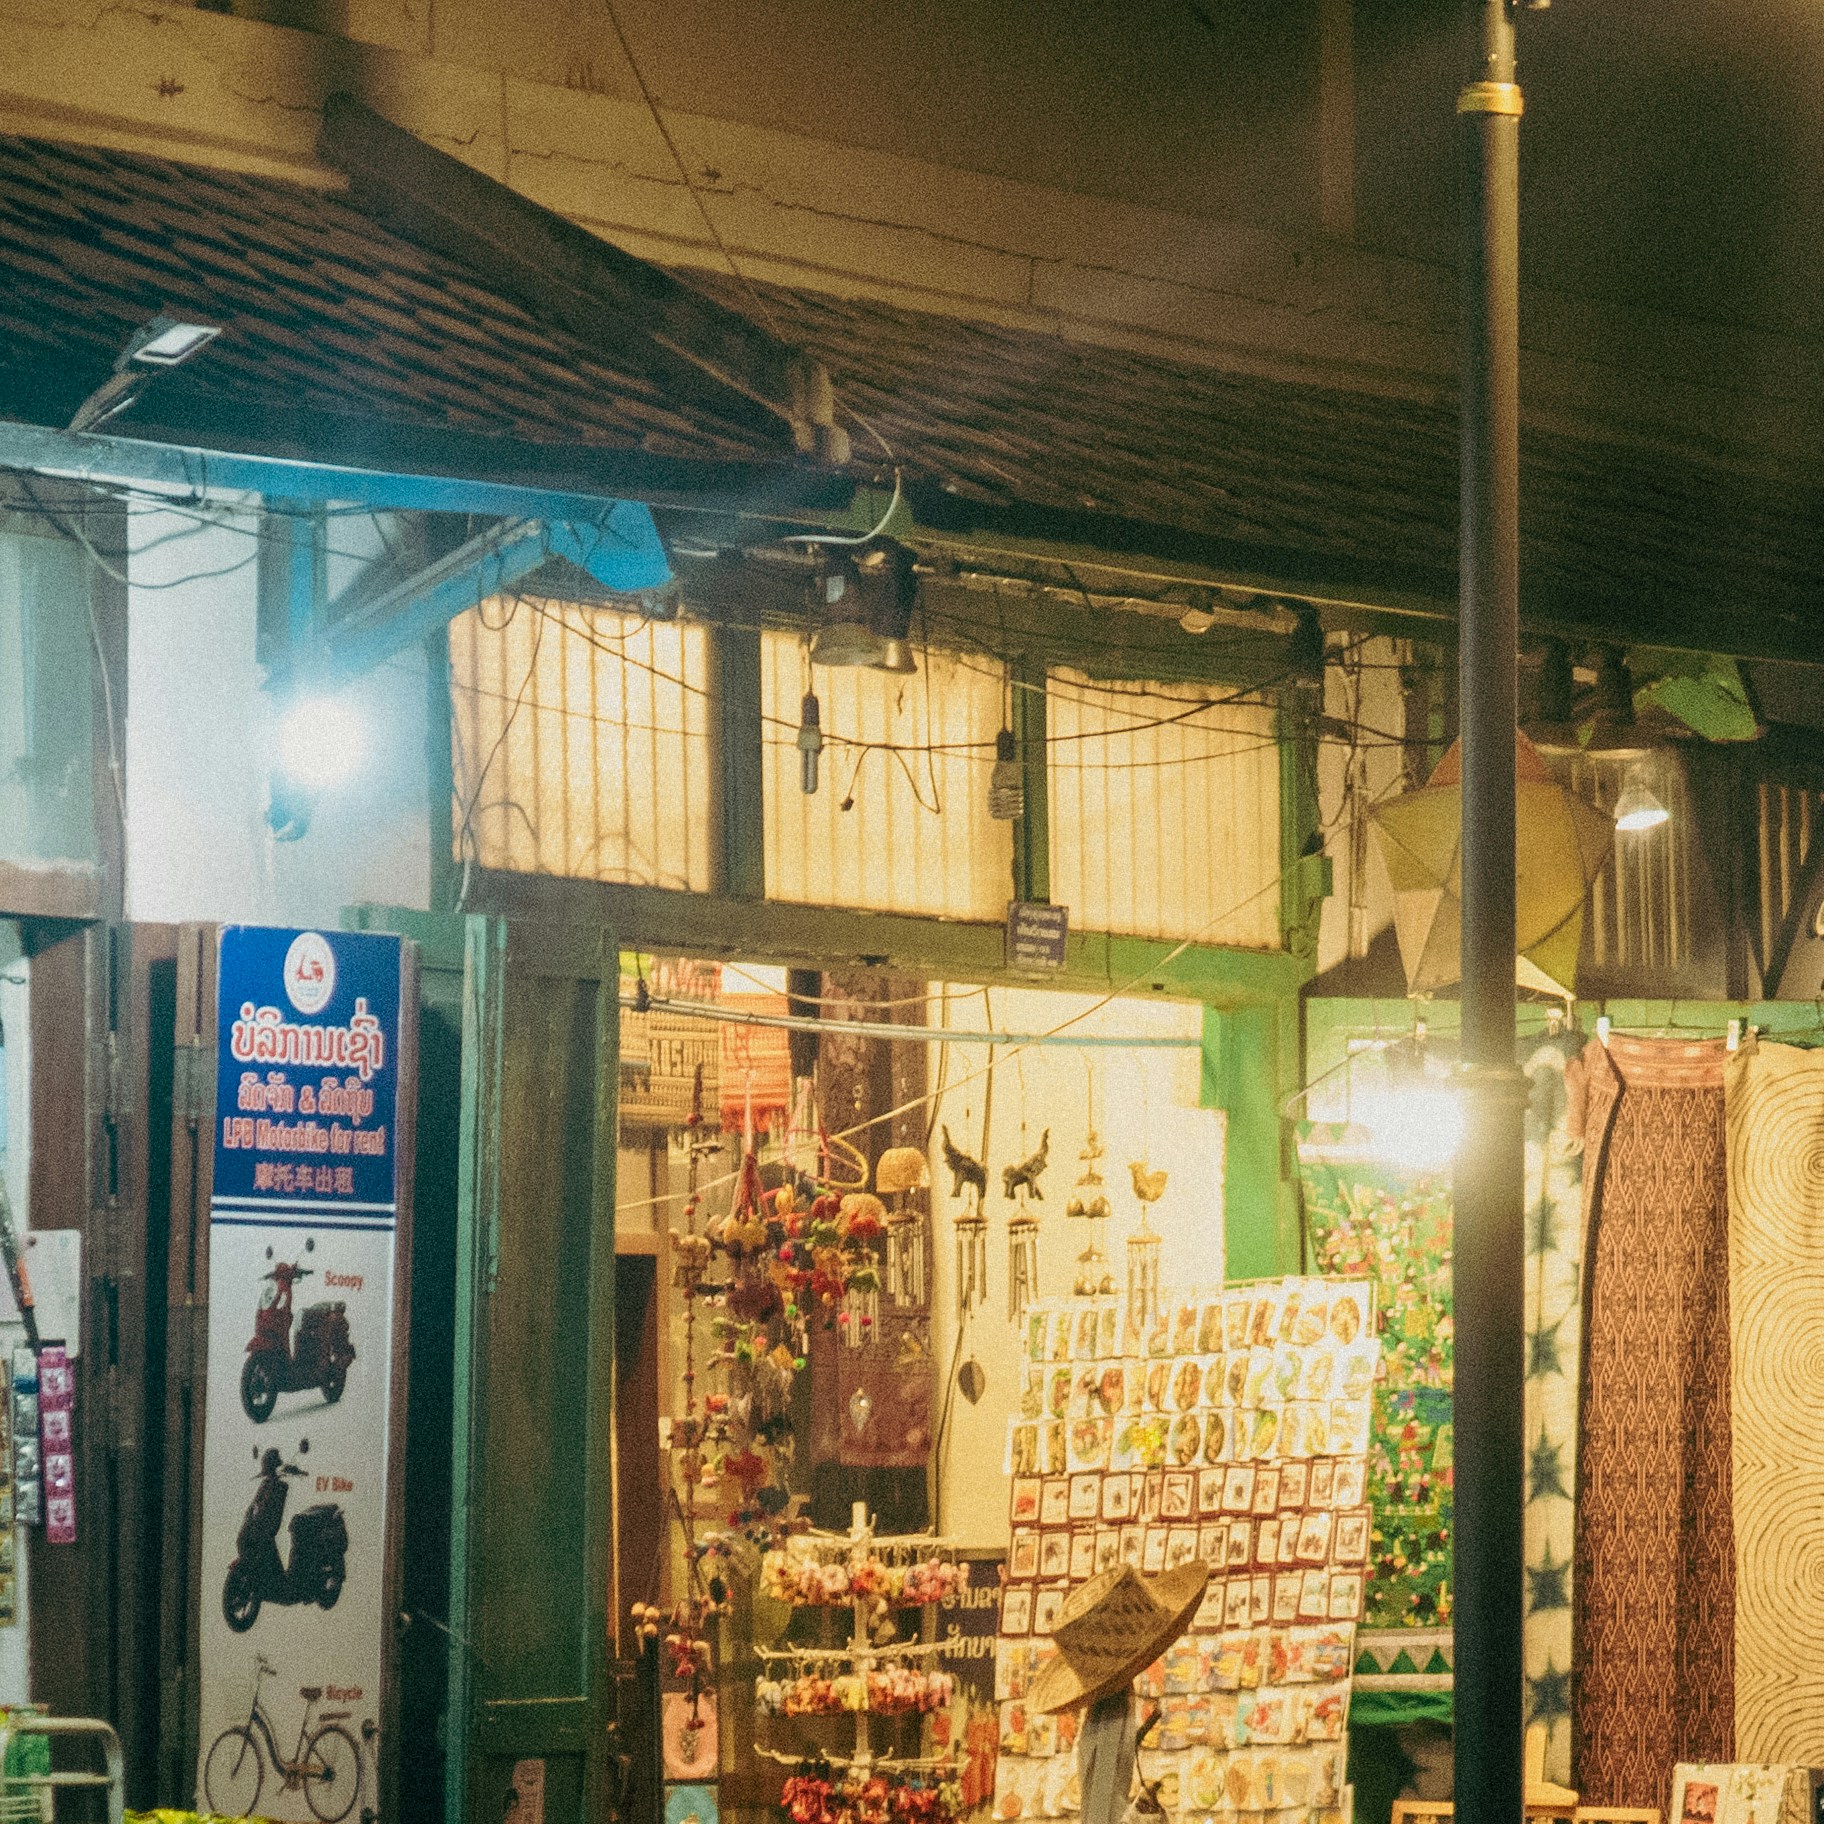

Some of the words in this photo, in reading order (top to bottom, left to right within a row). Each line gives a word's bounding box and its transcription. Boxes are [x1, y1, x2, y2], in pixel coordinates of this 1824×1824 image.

[299, 1085, 316, 1114] &
[223, 1116, 254, 1149] LPB
[256, 1119, 328, 1153] Motorbike
[330, 1122, 352, 1154] for
[353, 1125, 385, 1156] rent
[324, 1269, 364, 1292] Scoopy
[316, 1476, 330, 1492] EV
[332, 1476, 354, 1492] Bike
[326, 1684, 363, 1702] Bicycle
